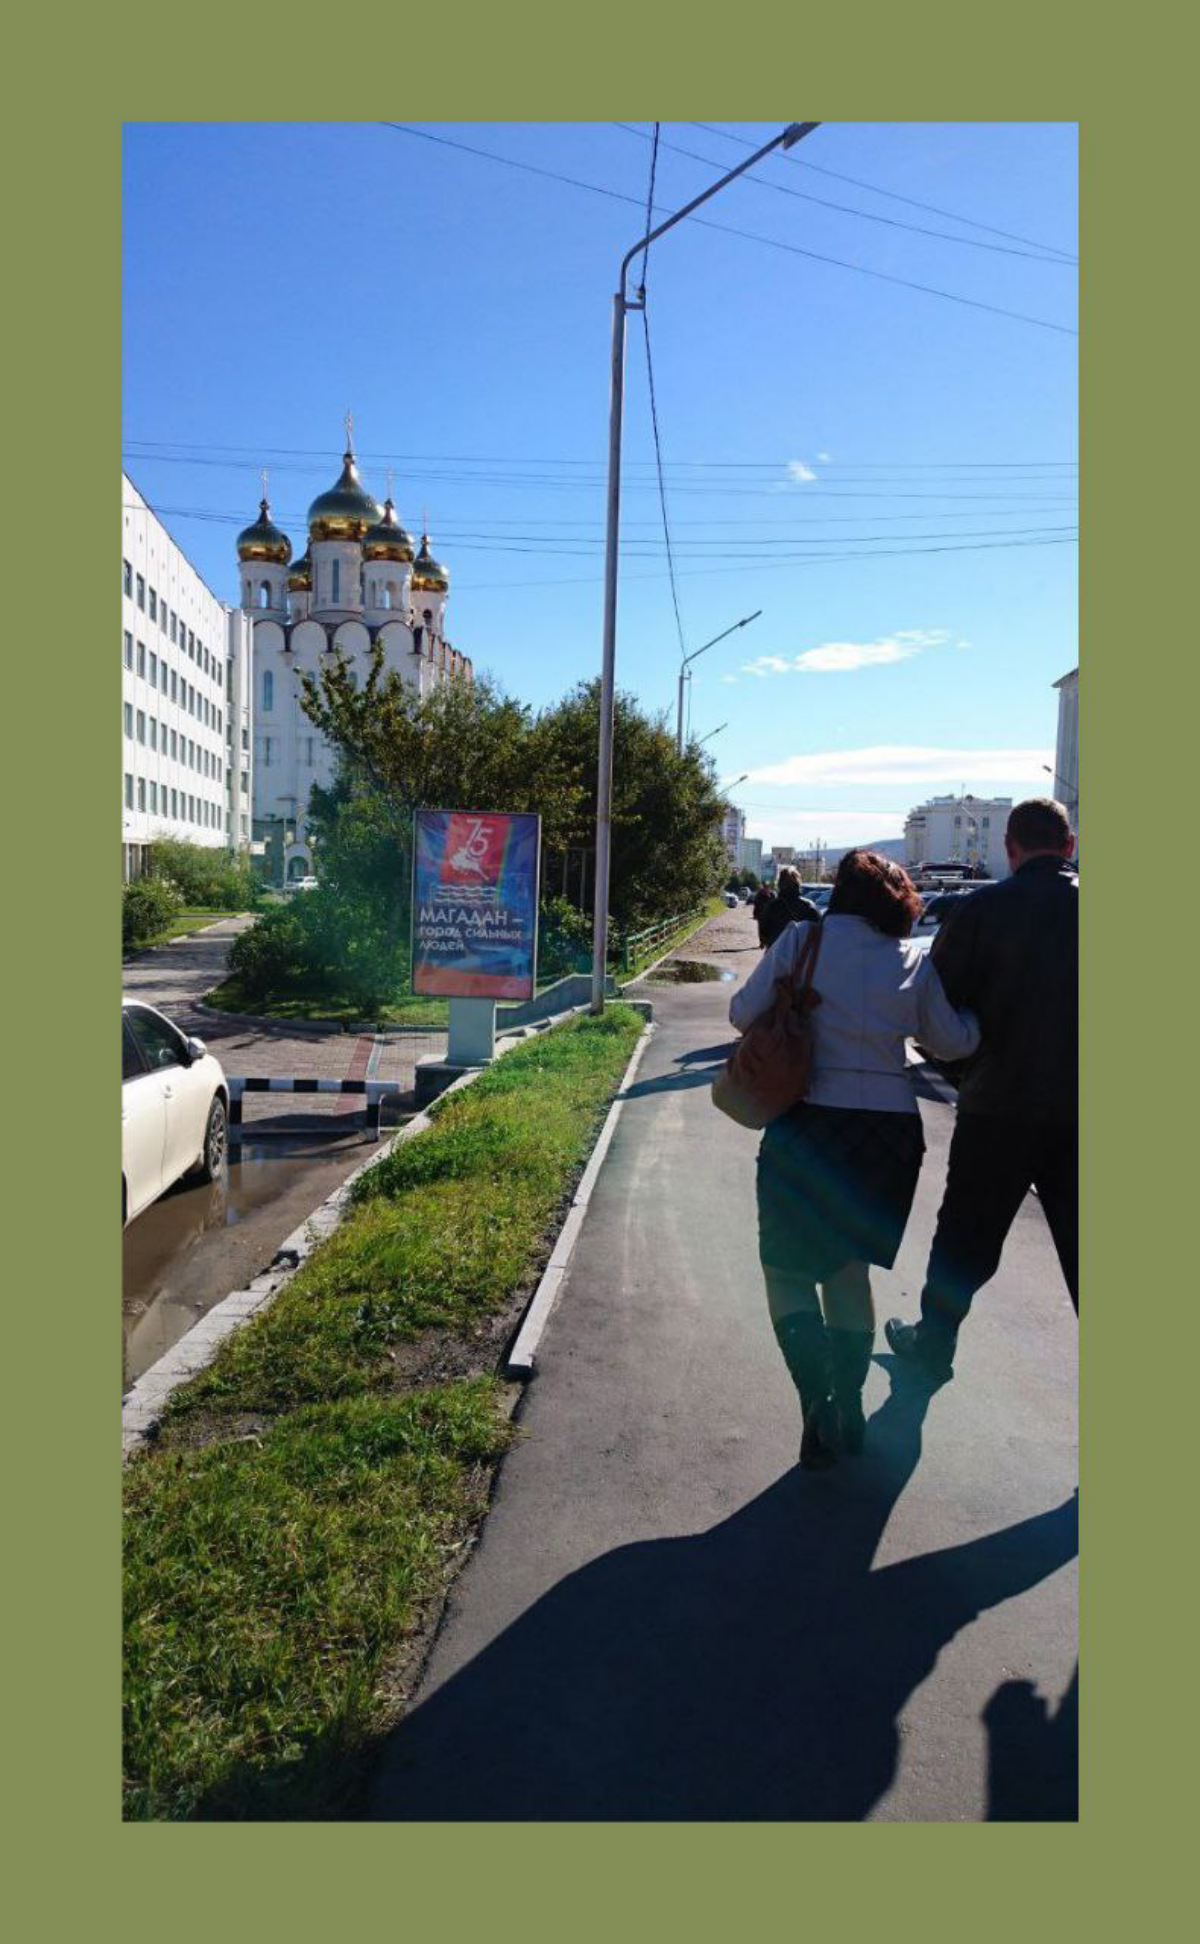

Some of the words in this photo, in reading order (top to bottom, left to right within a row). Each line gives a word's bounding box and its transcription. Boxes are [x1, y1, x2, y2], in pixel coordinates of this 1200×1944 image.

[466, 819, 493, 857] 75
[420, 909, 508, 925] МАГАДАН
[420, 927, 462, 939] город
[466, 928, 522, 940] сильных
[420, 939, 464, 951] людей
